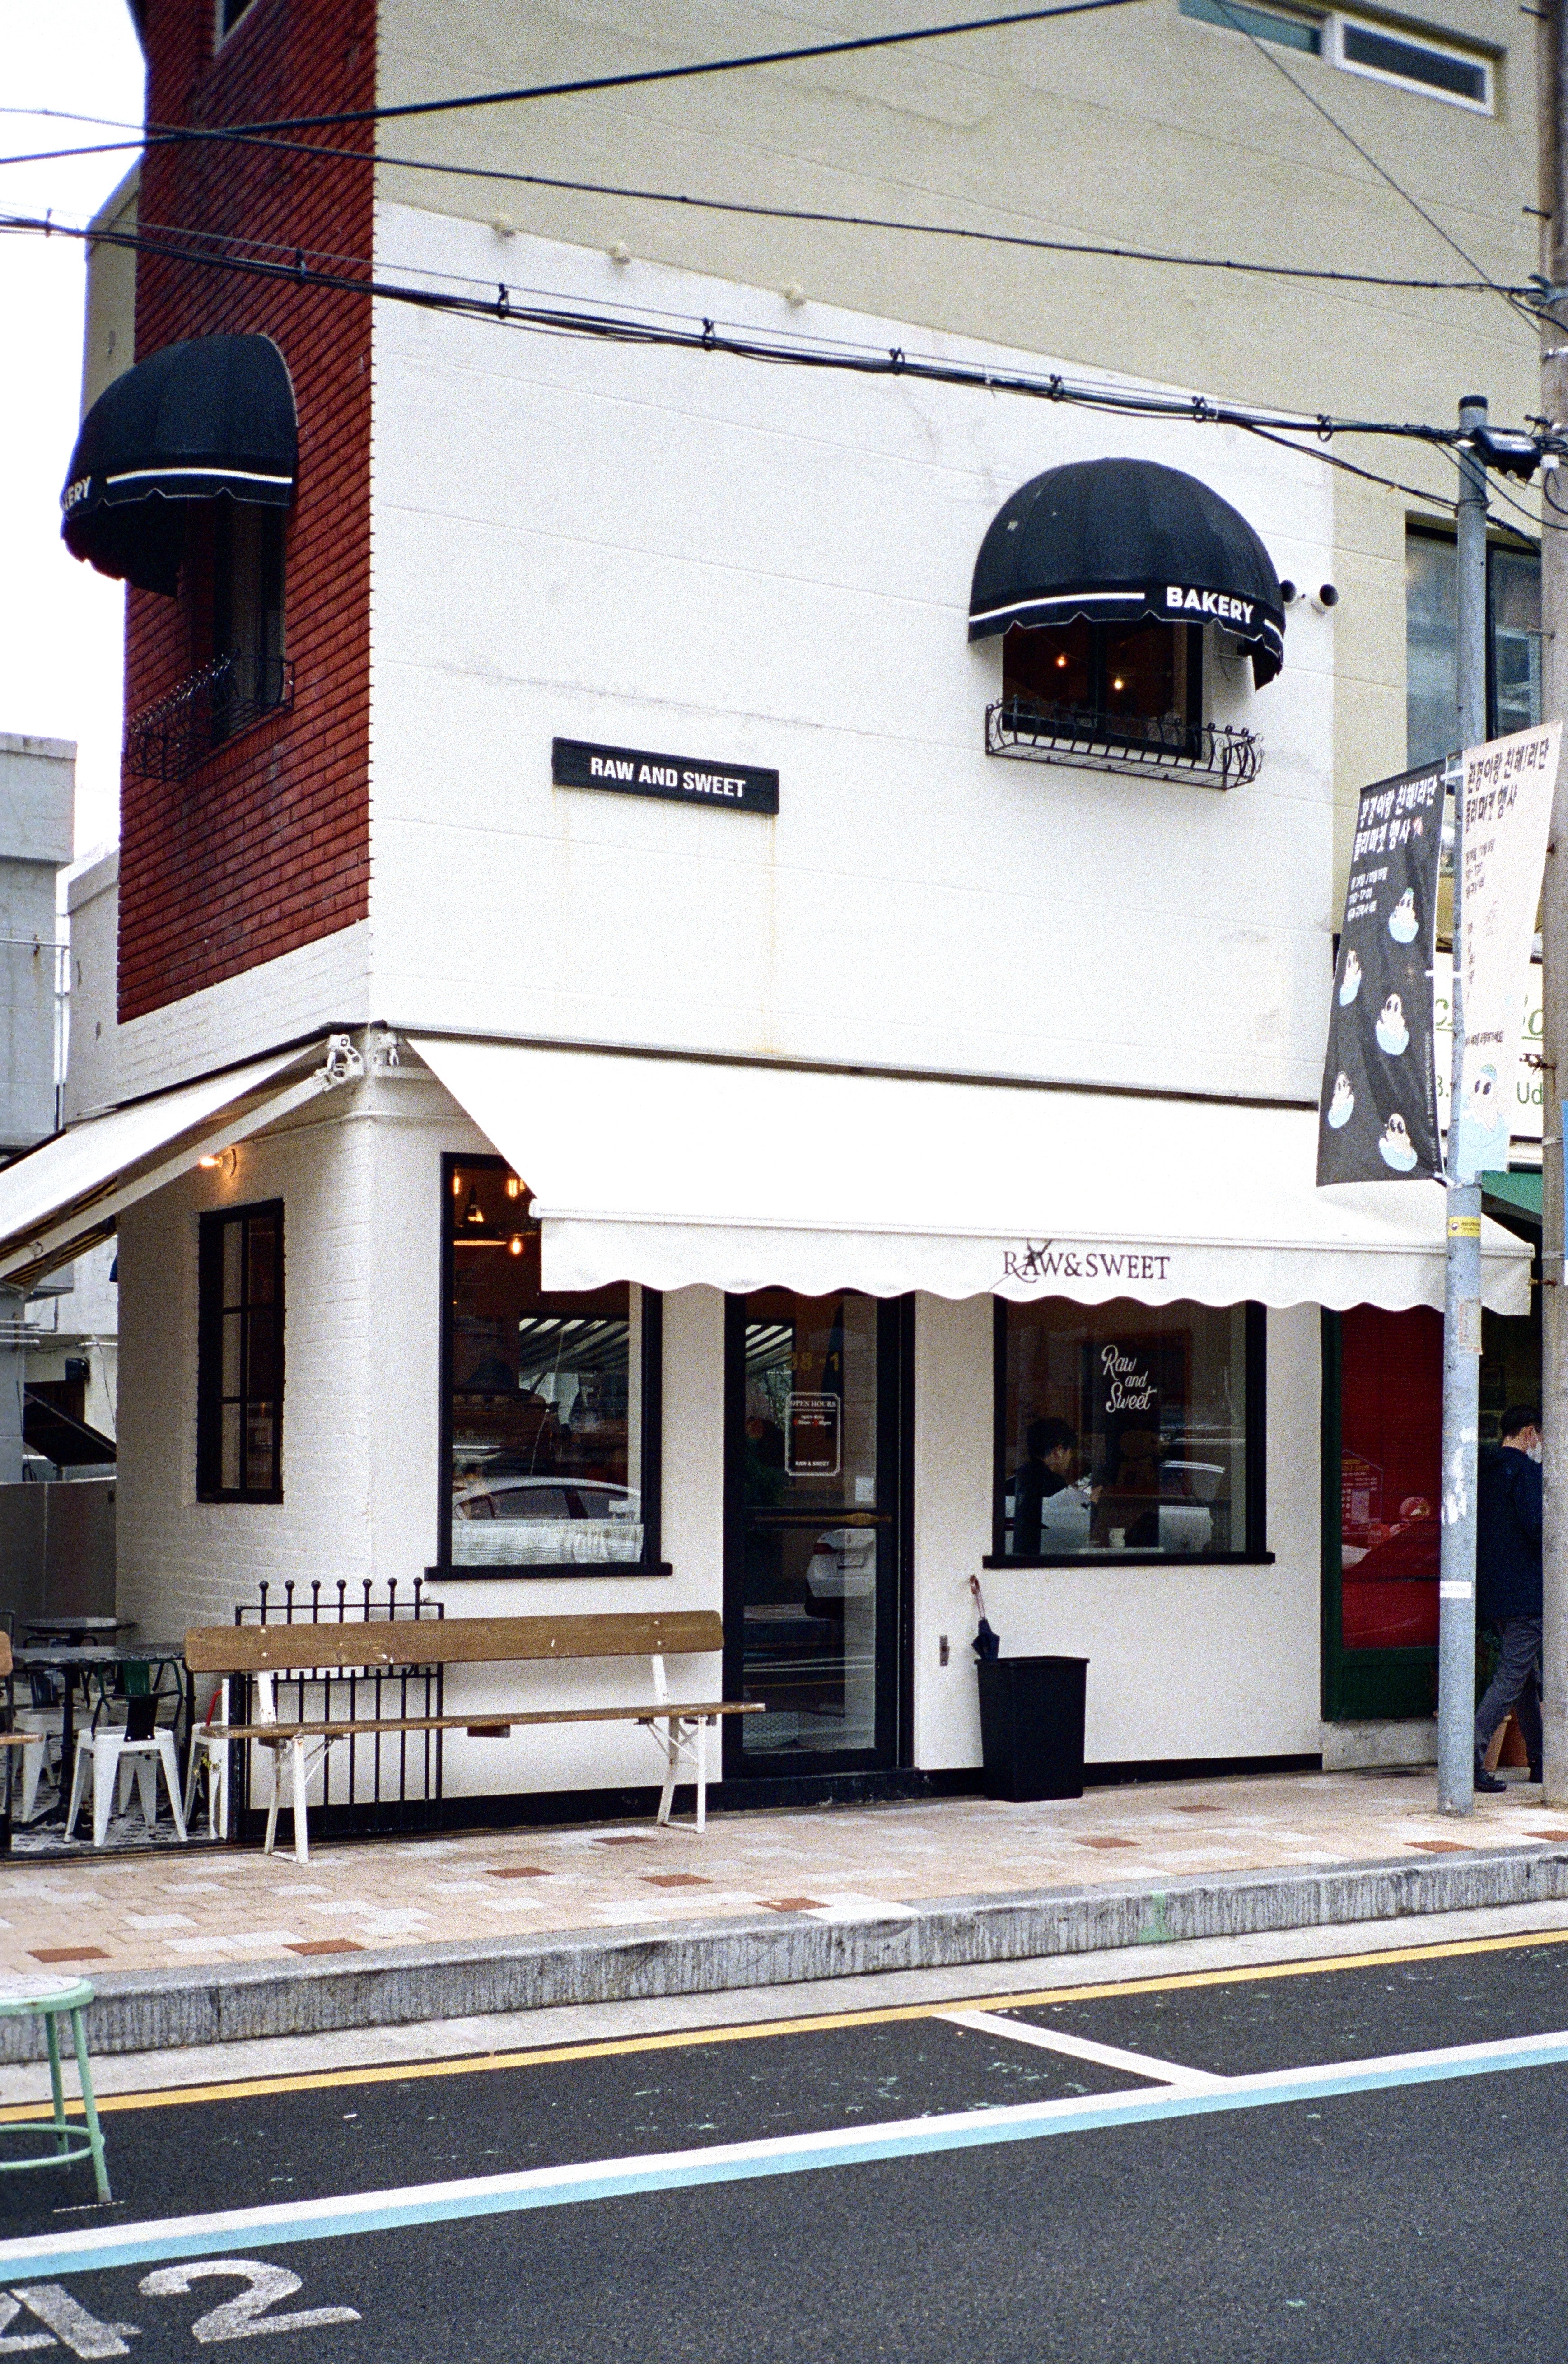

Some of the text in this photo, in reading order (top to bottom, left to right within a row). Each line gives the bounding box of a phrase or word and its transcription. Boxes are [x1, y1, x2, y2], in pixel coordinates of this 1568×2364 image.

[1167, 586, 1254, 624] BAKERY
[590, 757, 746, 798] RAW AND SWEET
[1497, 783, 1518, 819] 행사
[1389, 818, 1410, 851] 행사
[1101, 1345, 1137, 1380] Raw
[1125, 1371, 1148, 1387] and
[1106, 1382, 1157, 1413] Sweet
